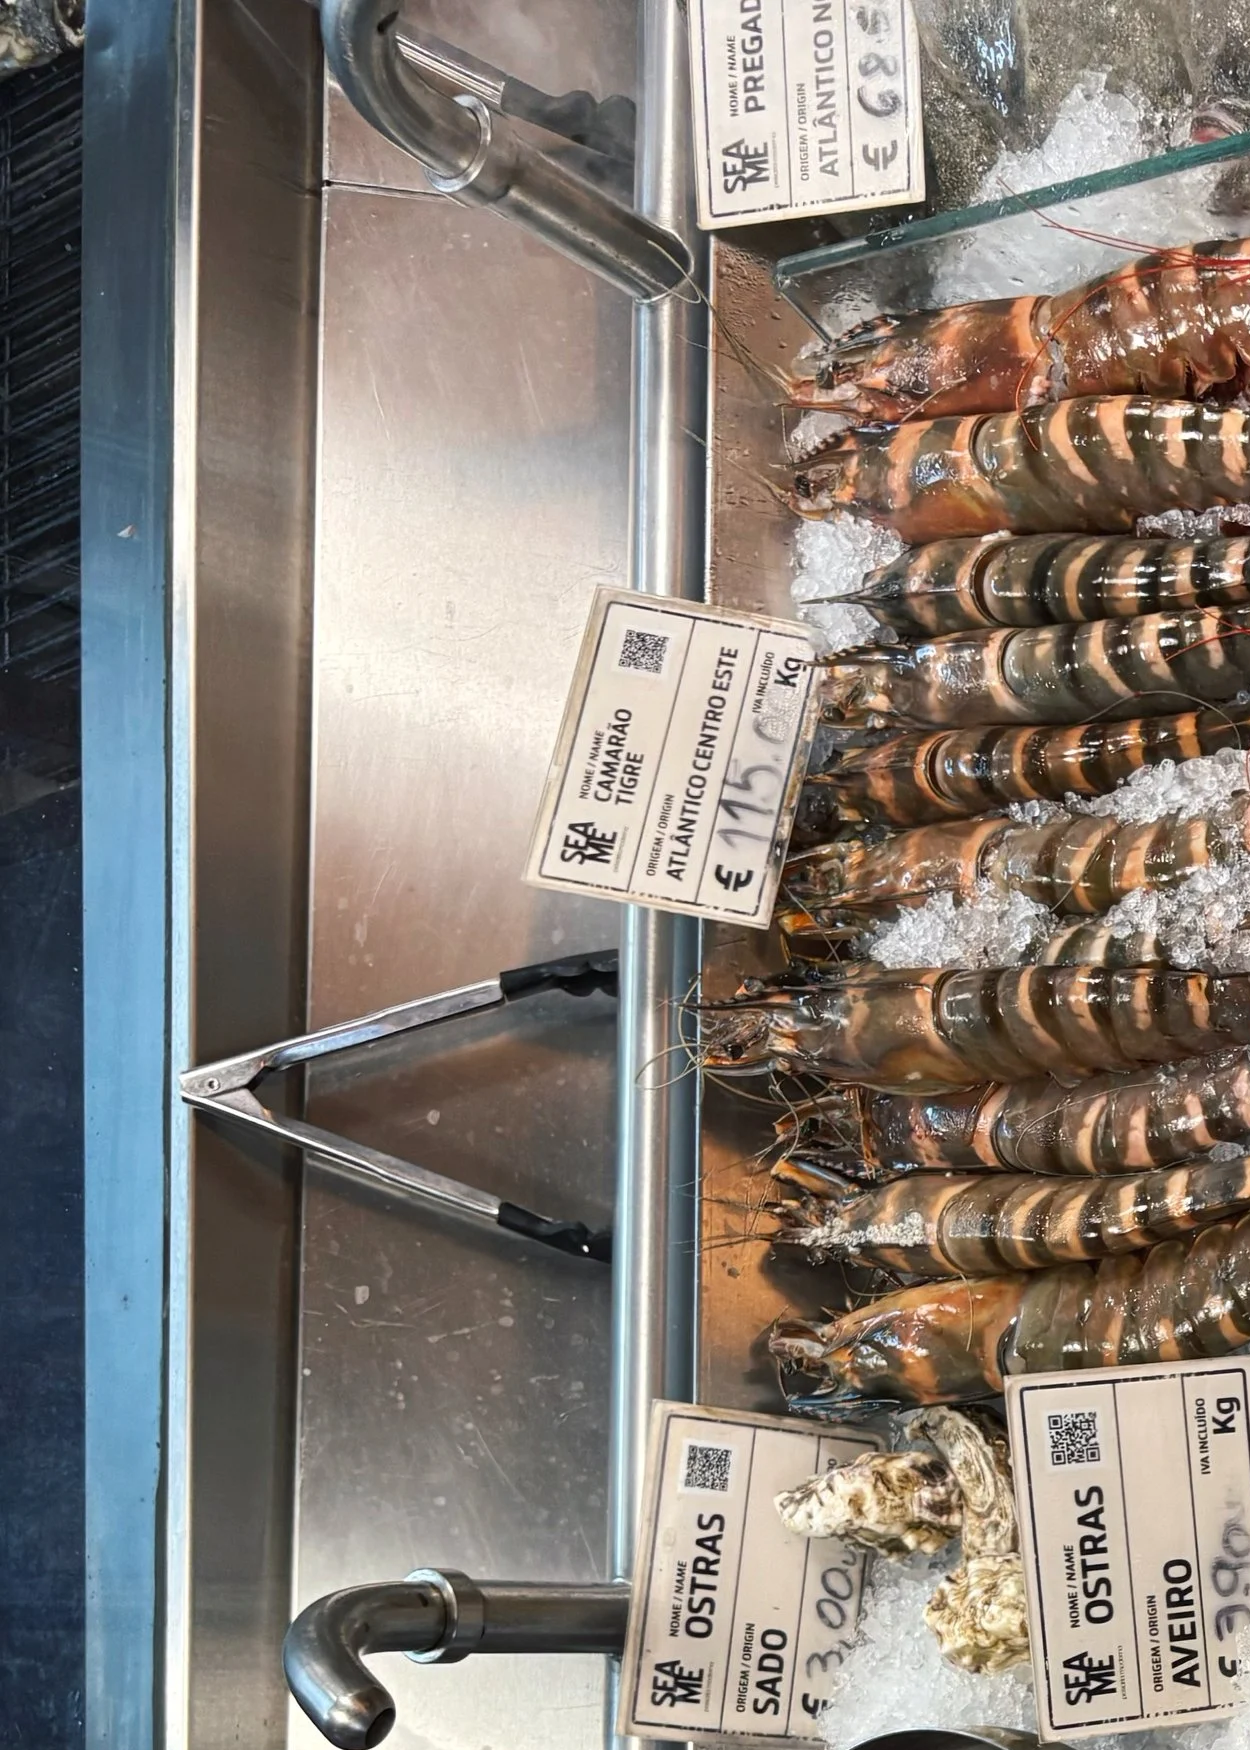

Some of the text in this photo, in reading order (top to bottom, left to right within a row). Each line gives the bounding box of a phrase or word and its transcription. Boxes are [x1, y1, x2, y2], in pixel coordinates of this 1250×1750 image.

[726, 36, 739, 117] NOME NAME
[812, 29, 840, 177] ATLÂNTICO
[721, 138, 751, 194] SEA
[740, 141, 770, 186] ME
[796, 83, 810, 181] ORIGEM ORIGIN
[752, 652, 775, 714] IVA INCLUÍDO
[773, 657, 810, 688] Kg
[578, 730, 604, 799] NOME NAME
[587, 708, 632, 802] CAMARÃO
[615, 752, 644, 805] TIGRE
[666, 646, 738, 882] ATLÂNTICO CENTRO ESTE
[560, 822, 597, 865] SEA
[584, 827, 617, 864] ME
[646, 794, 675, 876] ORIGEM ORIGIN
[714, 863, 754, 893] €
[1194, 1398, 1211, 1475] IVA INCLUÍDO
[1212, 1397, 1241, 1435] Kg
[684, 1514, 725, 1639] OSTRAS
[1063, 1545, 1080, 1628] NOME NAME
[1074, 1486, 1114, 1624] OSTRAS
[668, 1561, 687, 1637] NOME NAME
[1163, 1559, 1201, 1688] AVEIRO
[736, 1623, 755, 1713] ORIGEM ORIGIN
[752, 1629, 788, 1716] SADO
[1062, 1651, 1094, 1706] SEA
[1086, 1655, 1117, 1699] ME
[1146, 1595, 1164, 1693] ORIGEM ORIGIN
[651, 1660, 682, 1708] SEA
[671, 1664, 704, 1704] ME
